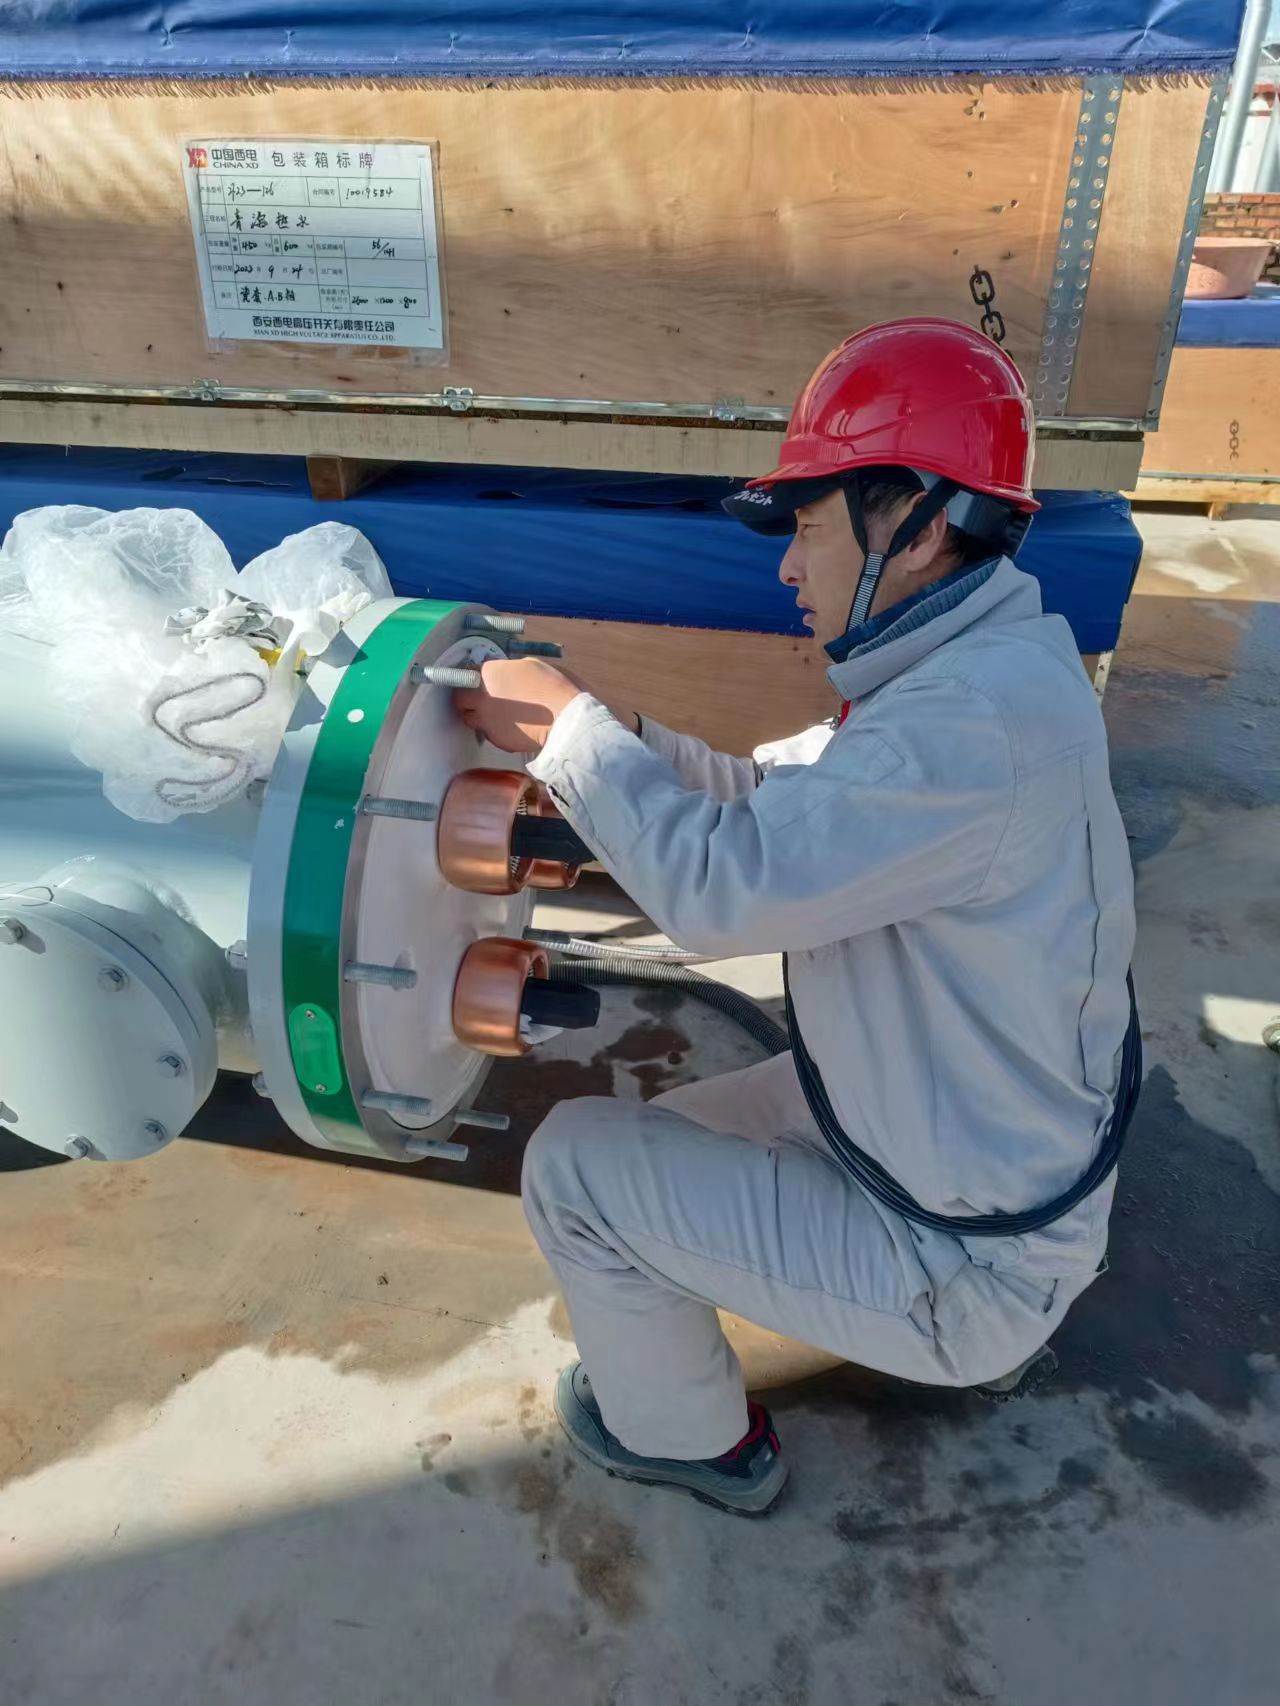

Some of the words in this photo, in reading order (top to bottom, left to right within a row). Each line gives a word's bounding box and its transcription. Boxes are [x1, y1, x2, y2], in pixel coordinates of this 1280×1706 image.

[211, 149, 257, 161] 中国西电
[271, 151, 374, 170] 包装箱标牌
[242, 240, 258, 251] 450
[252, 316, 395, 332] 西安西电高压开关有限责任公司
